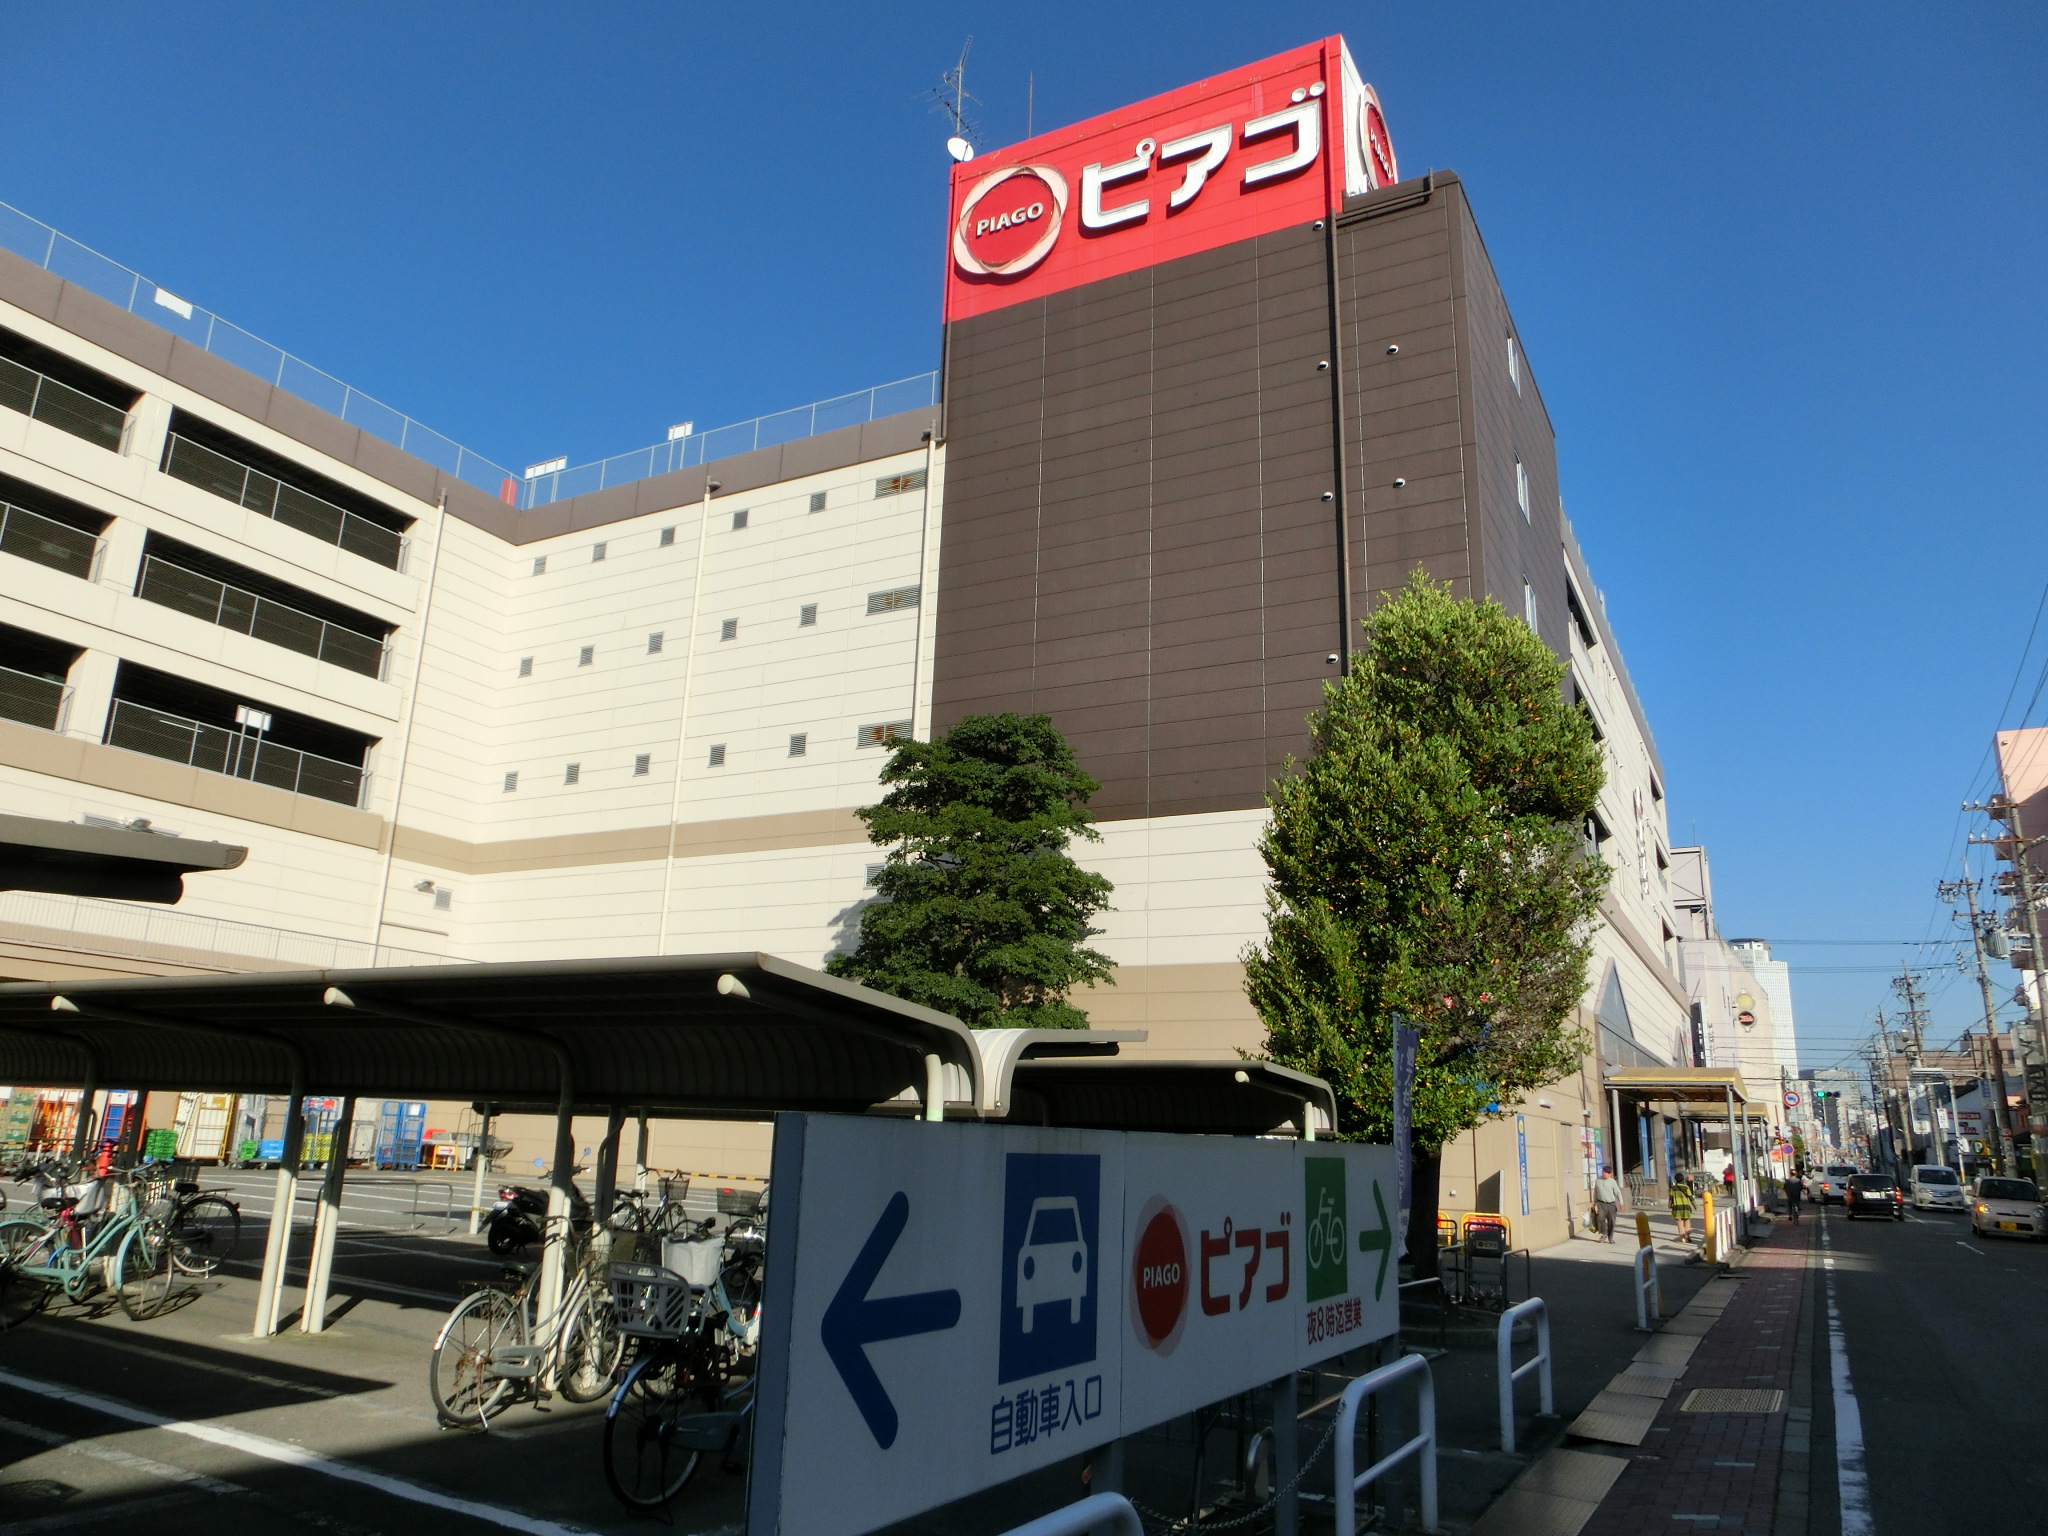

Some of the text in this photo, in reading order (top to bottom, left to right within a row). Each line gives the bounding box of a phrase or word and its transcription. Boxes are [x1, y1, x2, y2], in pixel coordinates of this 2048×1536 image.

[1082, 81, 1325, 228] ピアゴ
[976, 202, 1044, 237] PIAGO
[1143, 1262, 1181, 1289] PIAGO
[1200, 1211, 1291, 1317] ピアゴ
[1307, 1296, 1362, 1345] 夜8時迄営業
[991, 1374, 1102, 1455] 自動車入口
